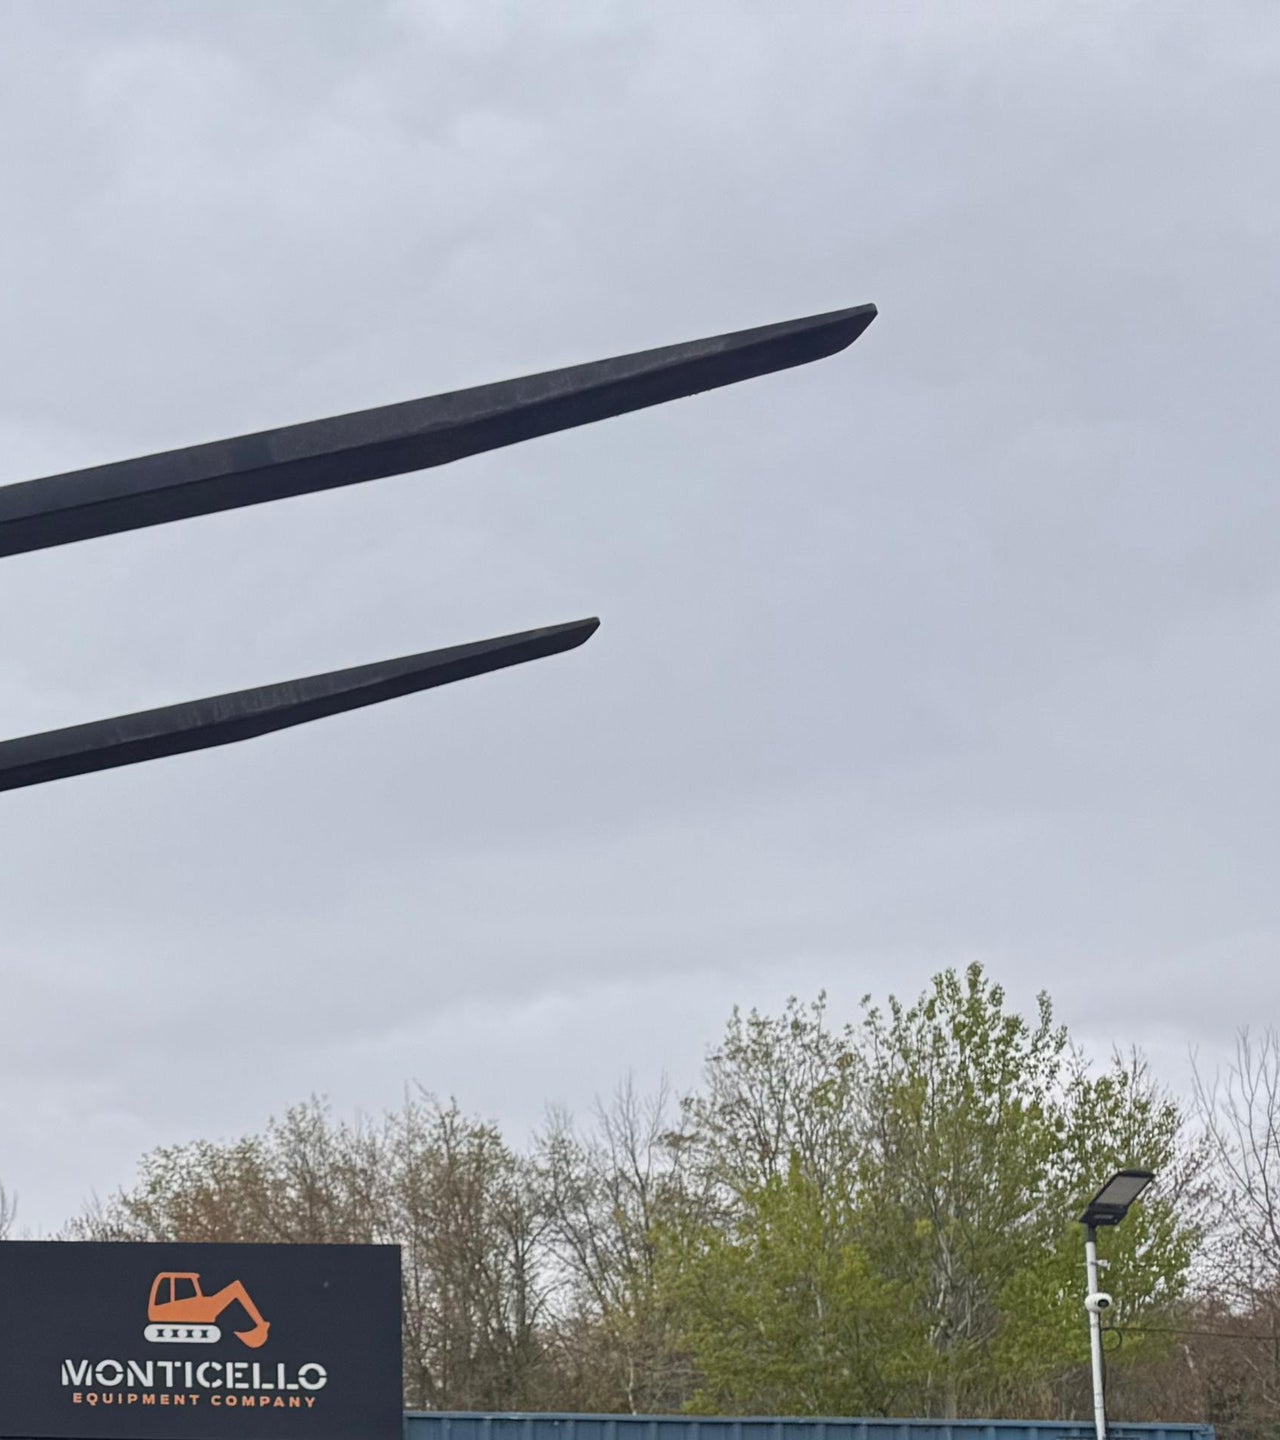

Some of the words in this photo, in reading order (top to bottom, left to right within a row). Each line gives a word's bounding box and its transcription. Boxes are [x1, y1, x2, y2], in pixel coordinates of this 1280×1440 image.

[61, 1359, 328, 1390] MONTICELLO
[73, 1393, 200, 1406] EQUIPMENT
[211, 1395, 316, 1407] COMPANY
